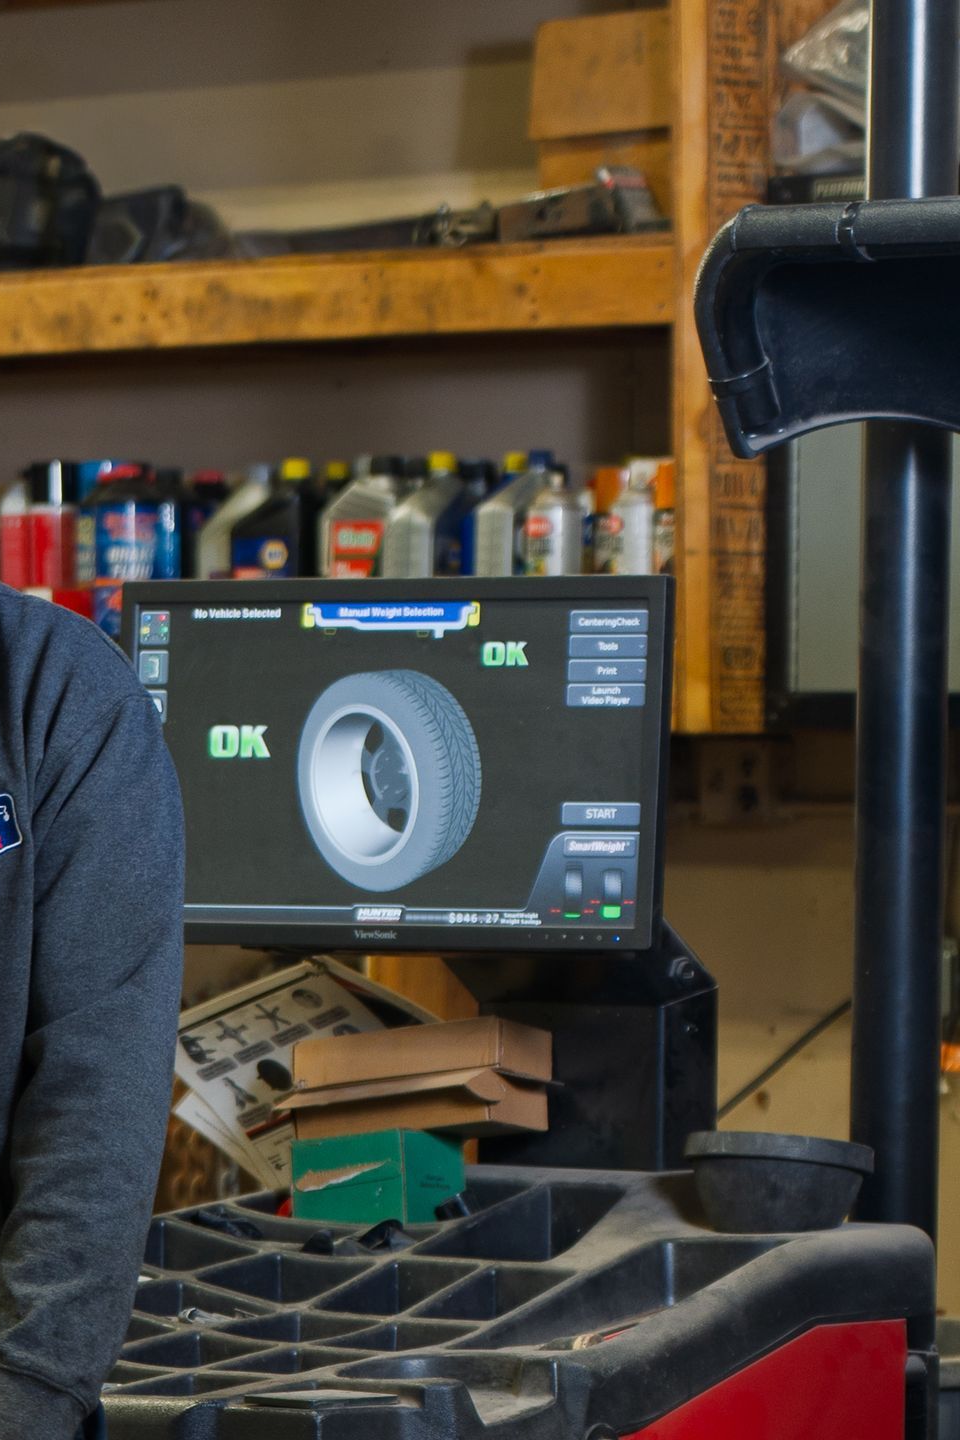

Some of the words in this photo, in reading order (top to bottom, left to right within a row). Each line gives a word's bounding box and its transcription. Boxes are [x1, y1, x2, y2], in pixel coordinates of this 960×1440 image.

[194, 608, 208, 619] No
[209, 608, 241, 619] Vehicle
[242, 608, 281, 619] Selected
[340, 607, 371, 617] Manual
[371, 607, 401, 618] Weight
[402, 607, 444, 617] Selection
[578, 617, 640, 628] CenteringCheck
[597, 641, 618, 651] Tools
[481, 641, 529, 667] OK
[596, 666, 617, 676] Print
[592, 686, 621, 695] Launch
[581, 696, 605, 705] Video
[208, 725, 270, 759] OK
[585, 808, 617, 819] START
[449, 912, 499, 924] $846.27
[353, 930, 397, 940] ViewSonic
